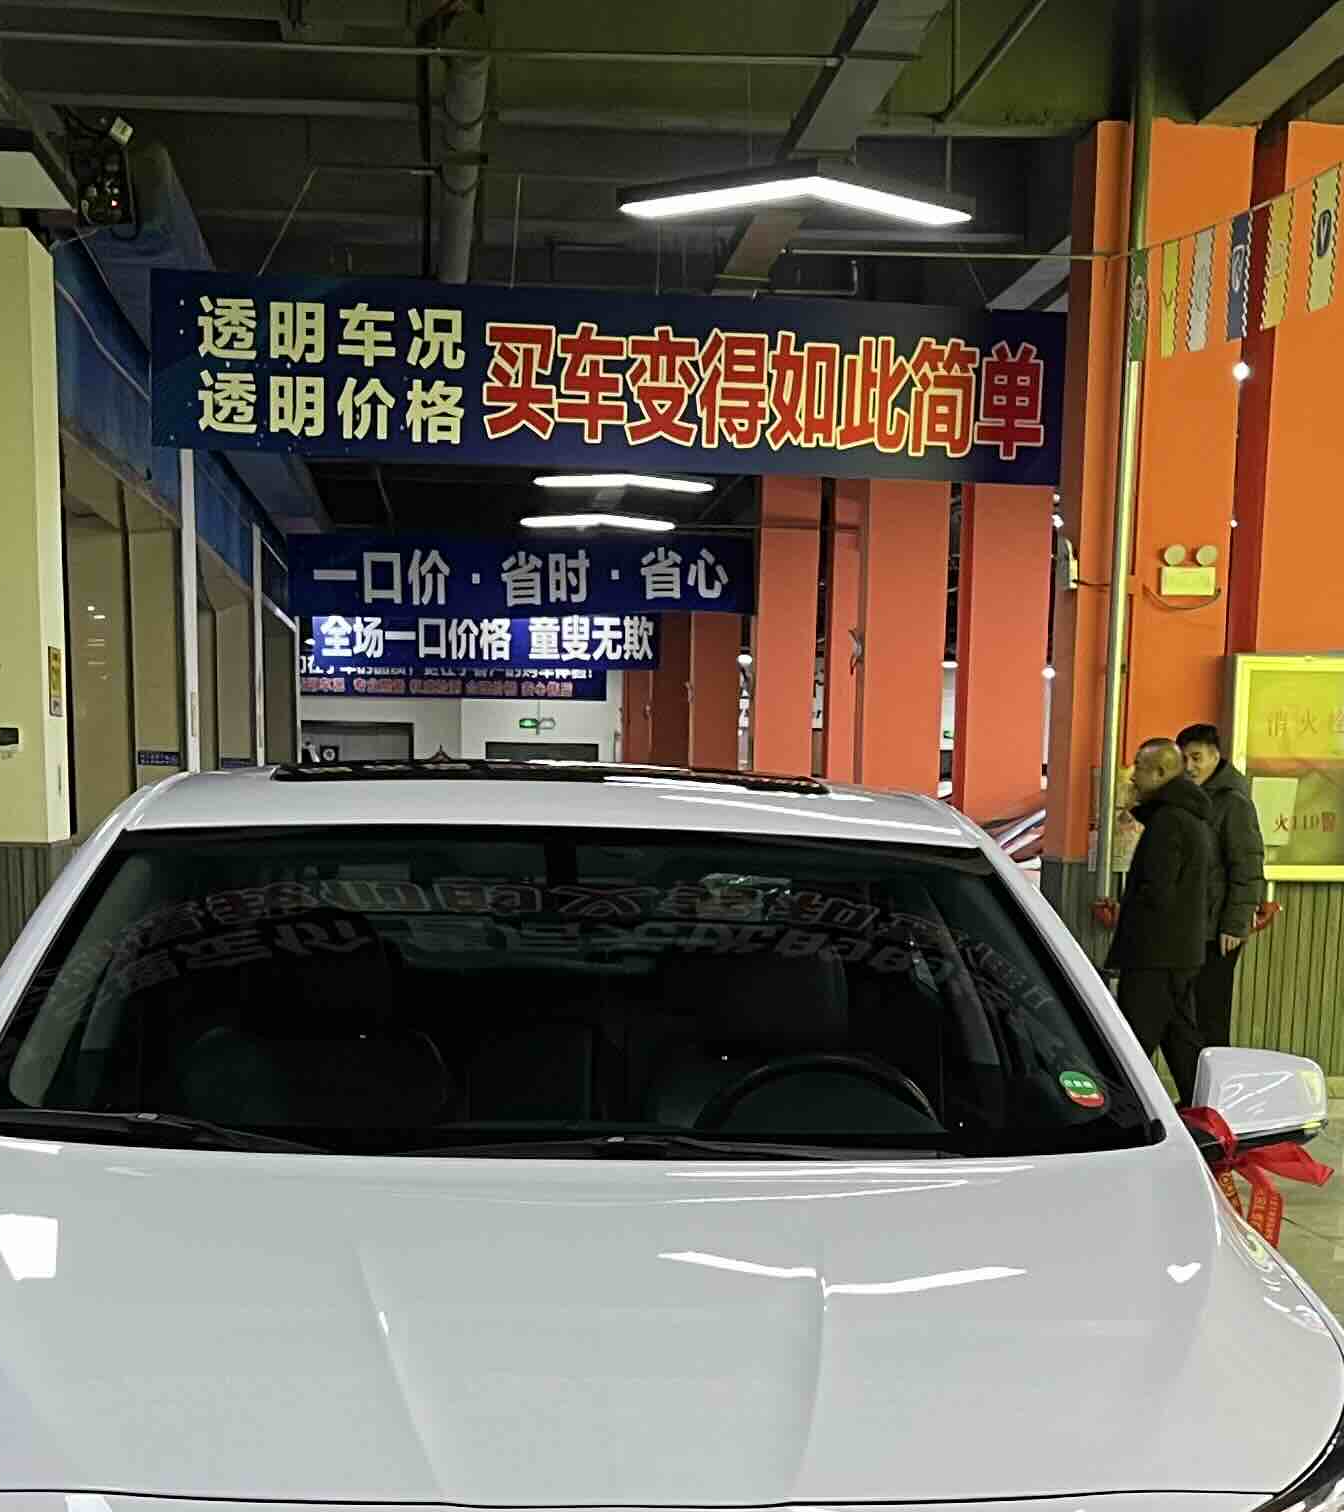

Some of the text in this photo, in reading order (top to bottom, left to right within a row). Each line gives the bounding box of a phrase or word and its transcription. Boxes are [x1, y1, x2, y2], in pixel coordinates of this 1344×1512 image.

[197, 296, 466, 370] 透明车况
[197, 370, 466, 445] 透明价格
[482, 321, 1045, 461] 买车变得如此简单
[320, 614, 655, 662] 全场一口价格 童叟无欺
